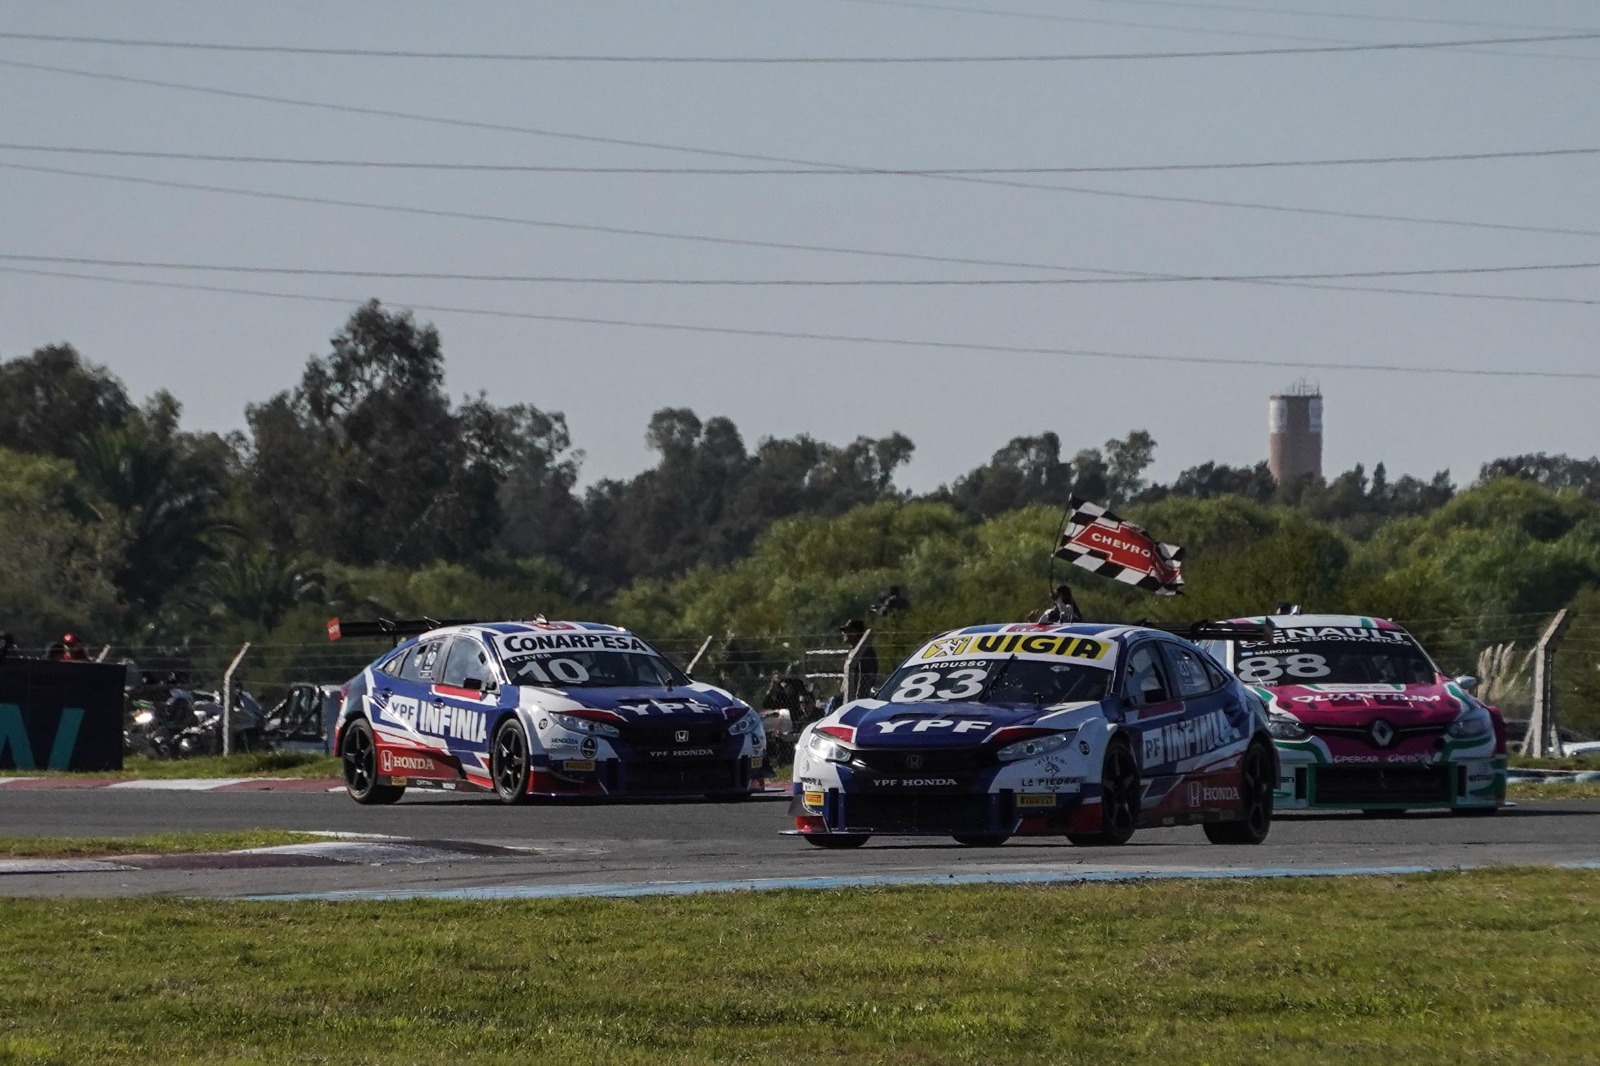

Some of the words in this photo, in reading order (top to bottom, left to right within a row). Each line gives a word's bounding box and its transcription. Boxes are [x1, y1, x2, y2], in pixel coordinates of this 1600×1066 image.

[1091, 532, 1151, 557] CHEVRO
[504, 635, 647, 652] CONARPESA
[510, 653, 551, 663] LLAVER
[921, 660, 986, 670] ARDUSSO
[517, 658, 590, 684] 10
[1238, 653, 1331, 682] 88
[891, 669, 987, 702] 83
[391, 702, 415, 720] YPF
[620, 702, 710, 716] YPF
[876, 720, 992, 734] YPF
[1165, 709, 1240, 762] INFINIA
[394, 756, 435, 770] HONDA
[902, 778, 958, 786] HONDA
[1021, 778, 1034, 786] LA
[1203, 787, 1240, 800] HONDA
